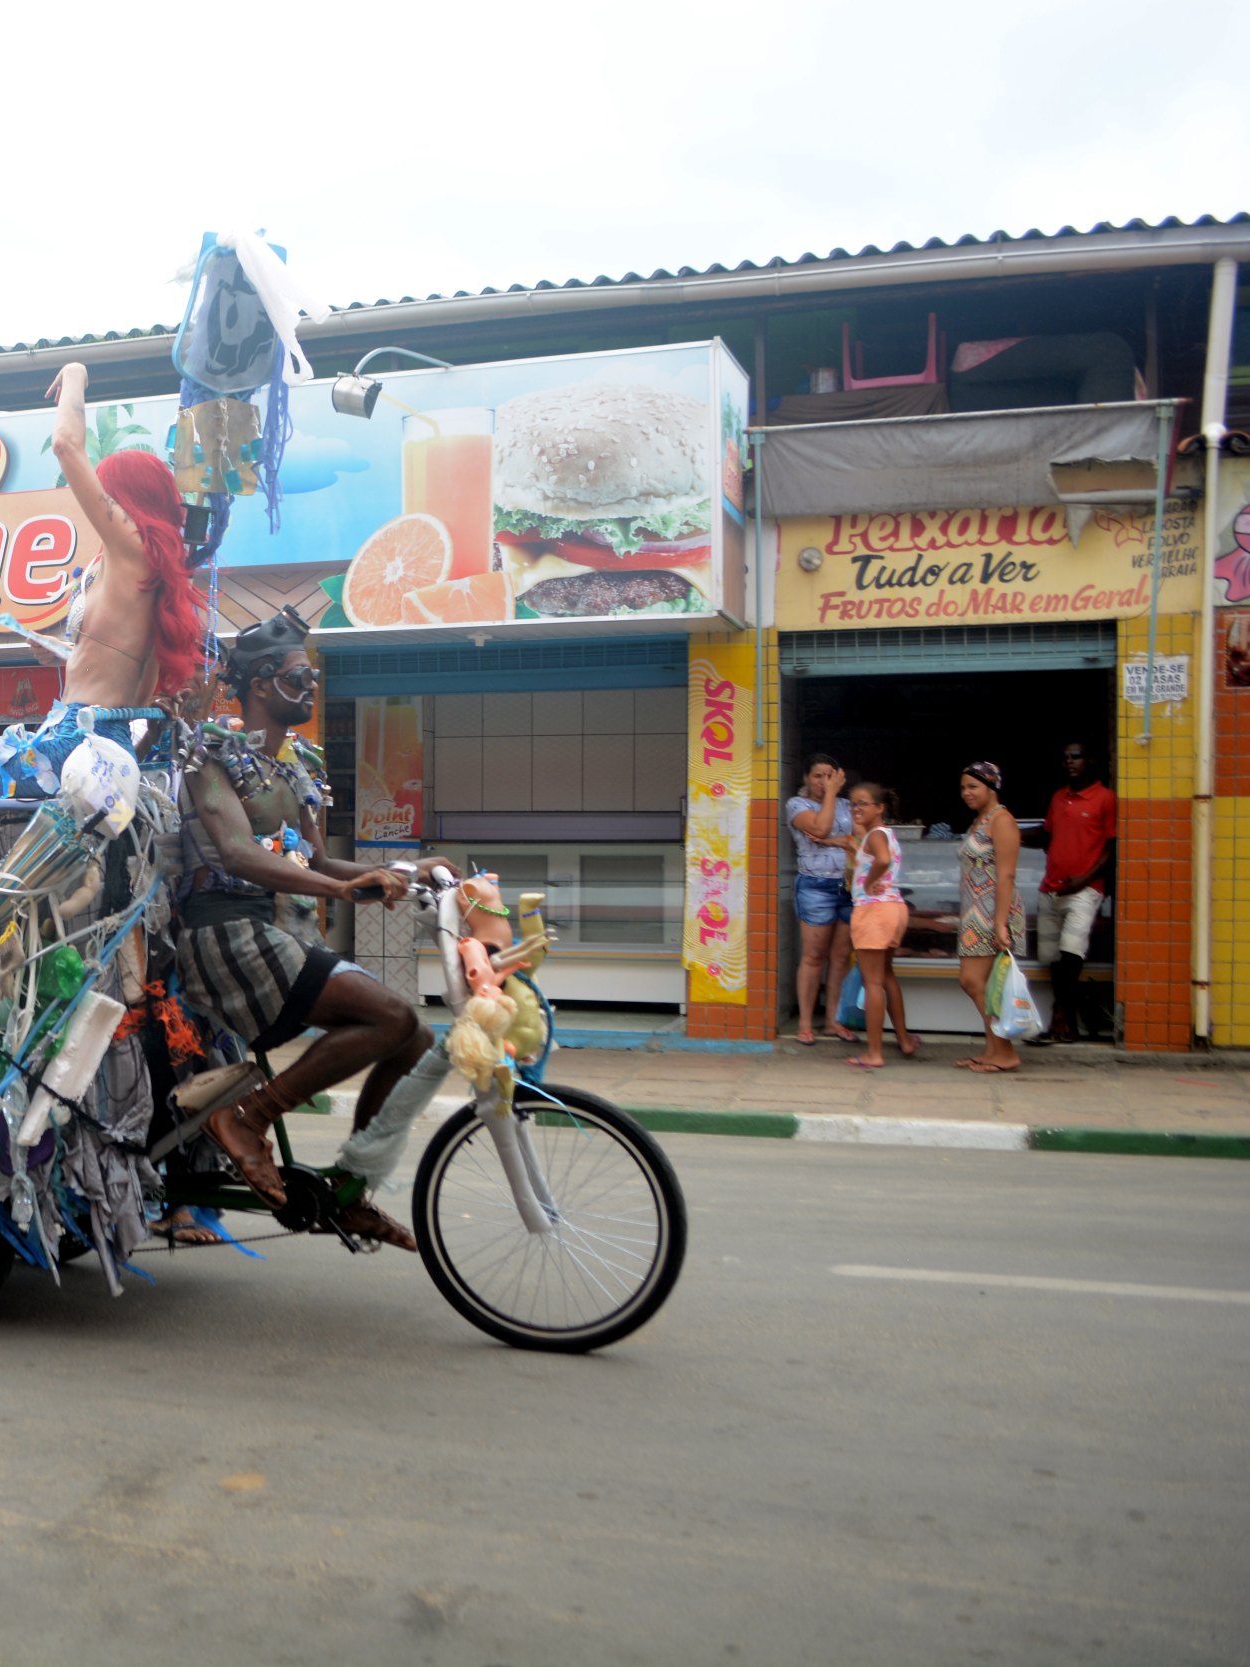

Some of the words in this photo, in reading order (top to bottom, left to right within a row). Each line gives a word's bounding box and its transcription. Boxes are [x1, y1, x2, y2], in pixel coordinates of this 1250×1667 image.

[824, 506, 1070, 556] Peixaria
[851, 553, 948, 590] Tudo
[948, 562, 975, 585] a
[981, 551, 1040, 584] Ver
[819, 591, 922, 623] FRUTOS
[925, 589, 960, 617] do
[958, 587, 1028, 616] MAR
[1030, 595, 1069, 613] em
[1126, 664, 1185, 675] VENDE-SE
[1128, 675, 1142, 685] 02
[1152, 673, 1182, 684] ASAS
[701, 677, 735, 767] SKOL
[374, 823, 410, 840] Lanche
